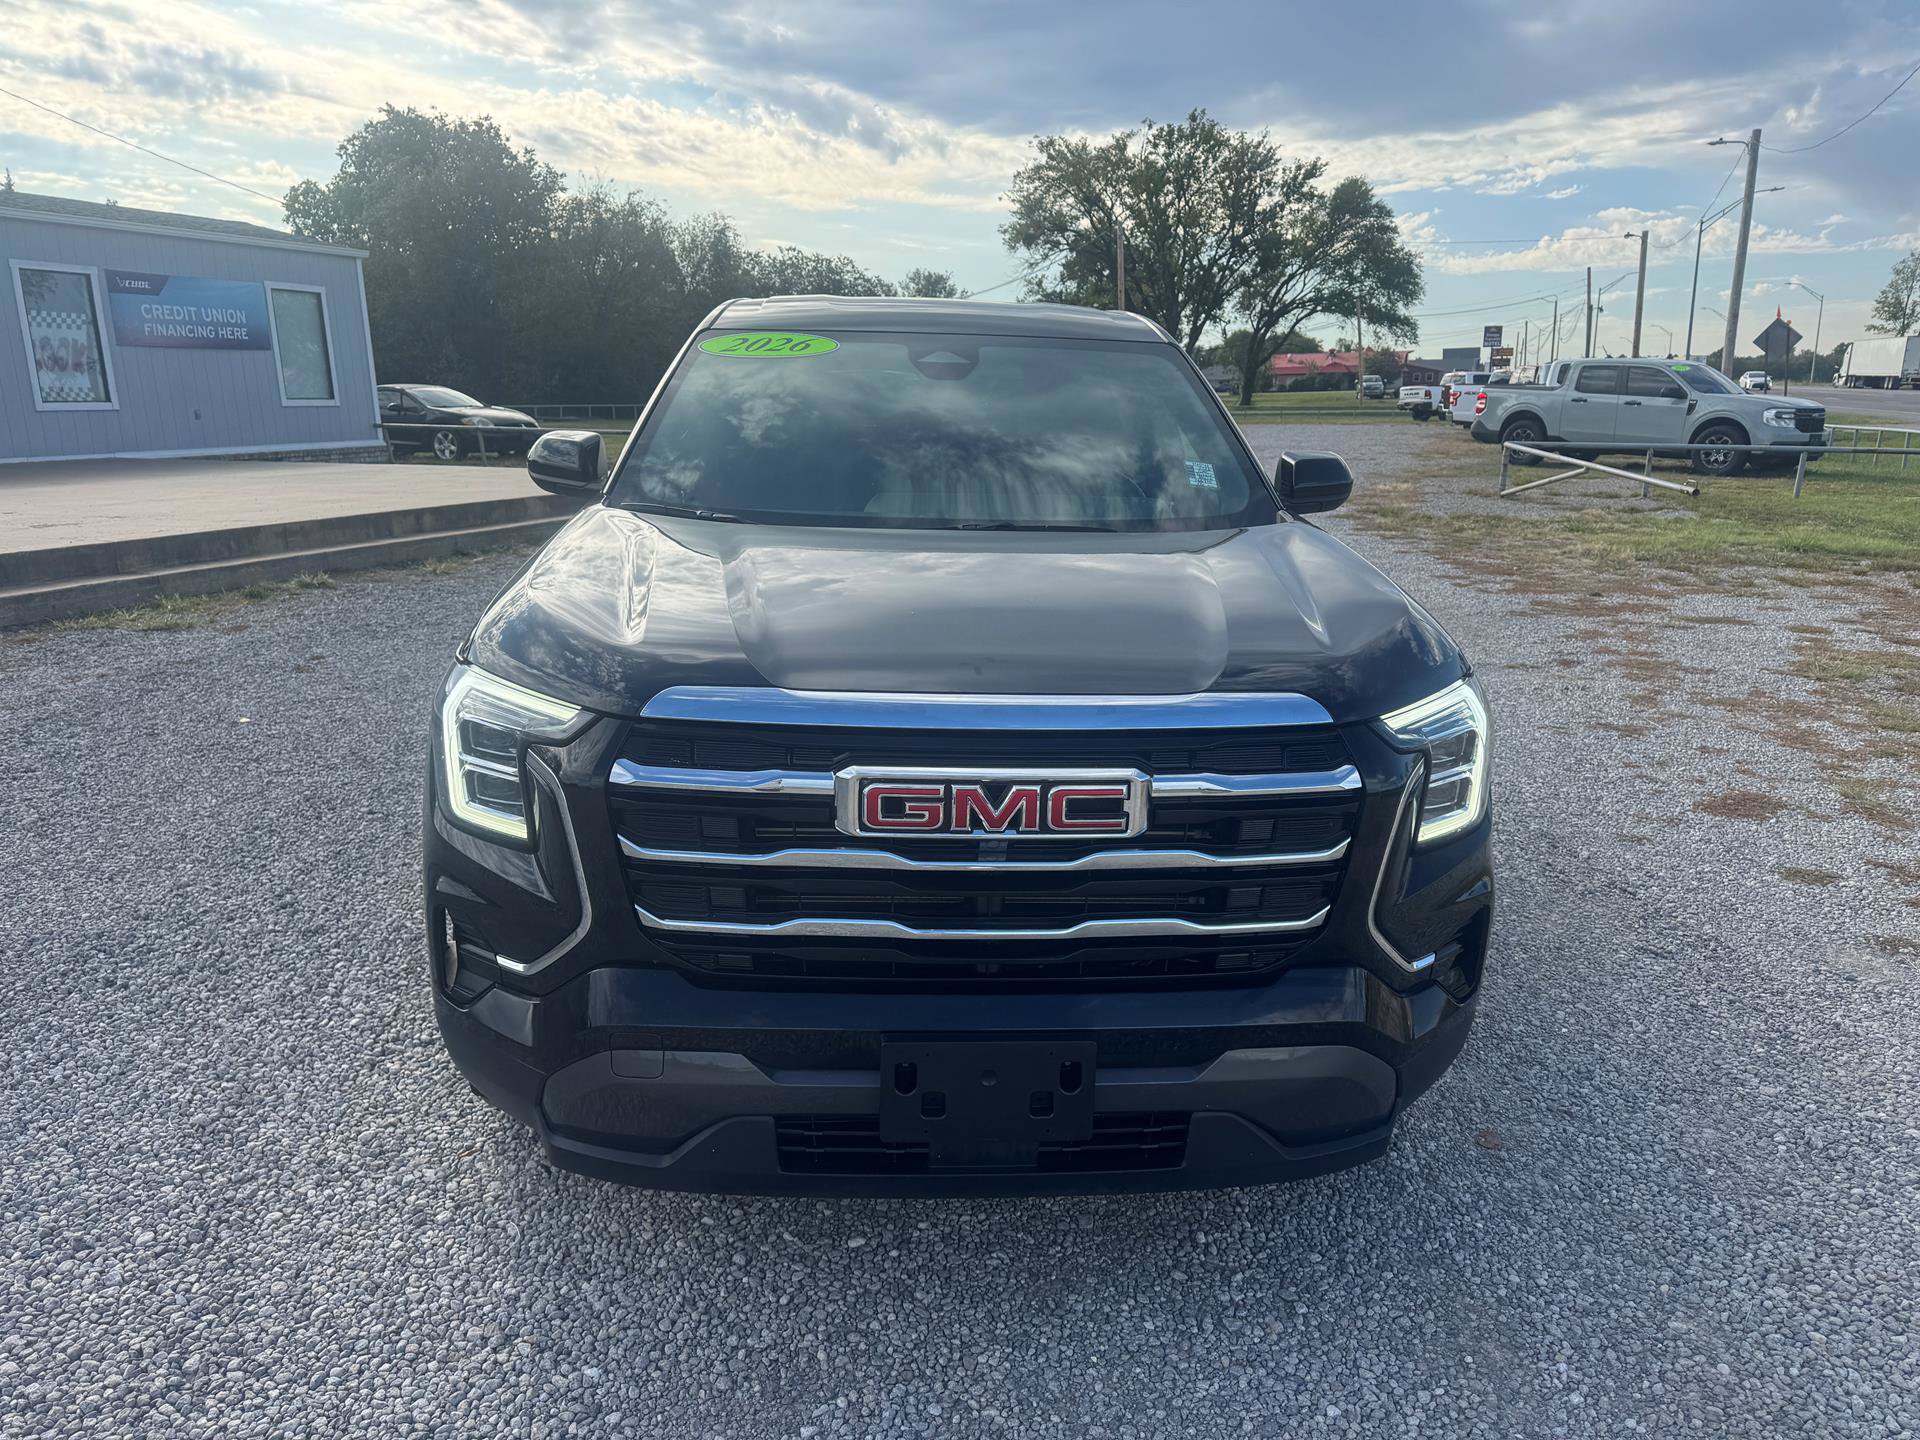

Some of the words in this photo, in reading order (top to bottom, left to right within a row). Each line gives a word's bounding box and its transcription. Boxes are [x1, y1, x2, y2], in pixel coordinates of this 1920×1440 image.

[141, 303, 197, 321] CREDIT
[201, 307, 247, 323] UNION
[144, 323, 215, 338] FINANCING
[219, 327, 249, 340] HERE
[719, 337, 817, 353] 2026
[862, 784, 1129, 831] GMC
